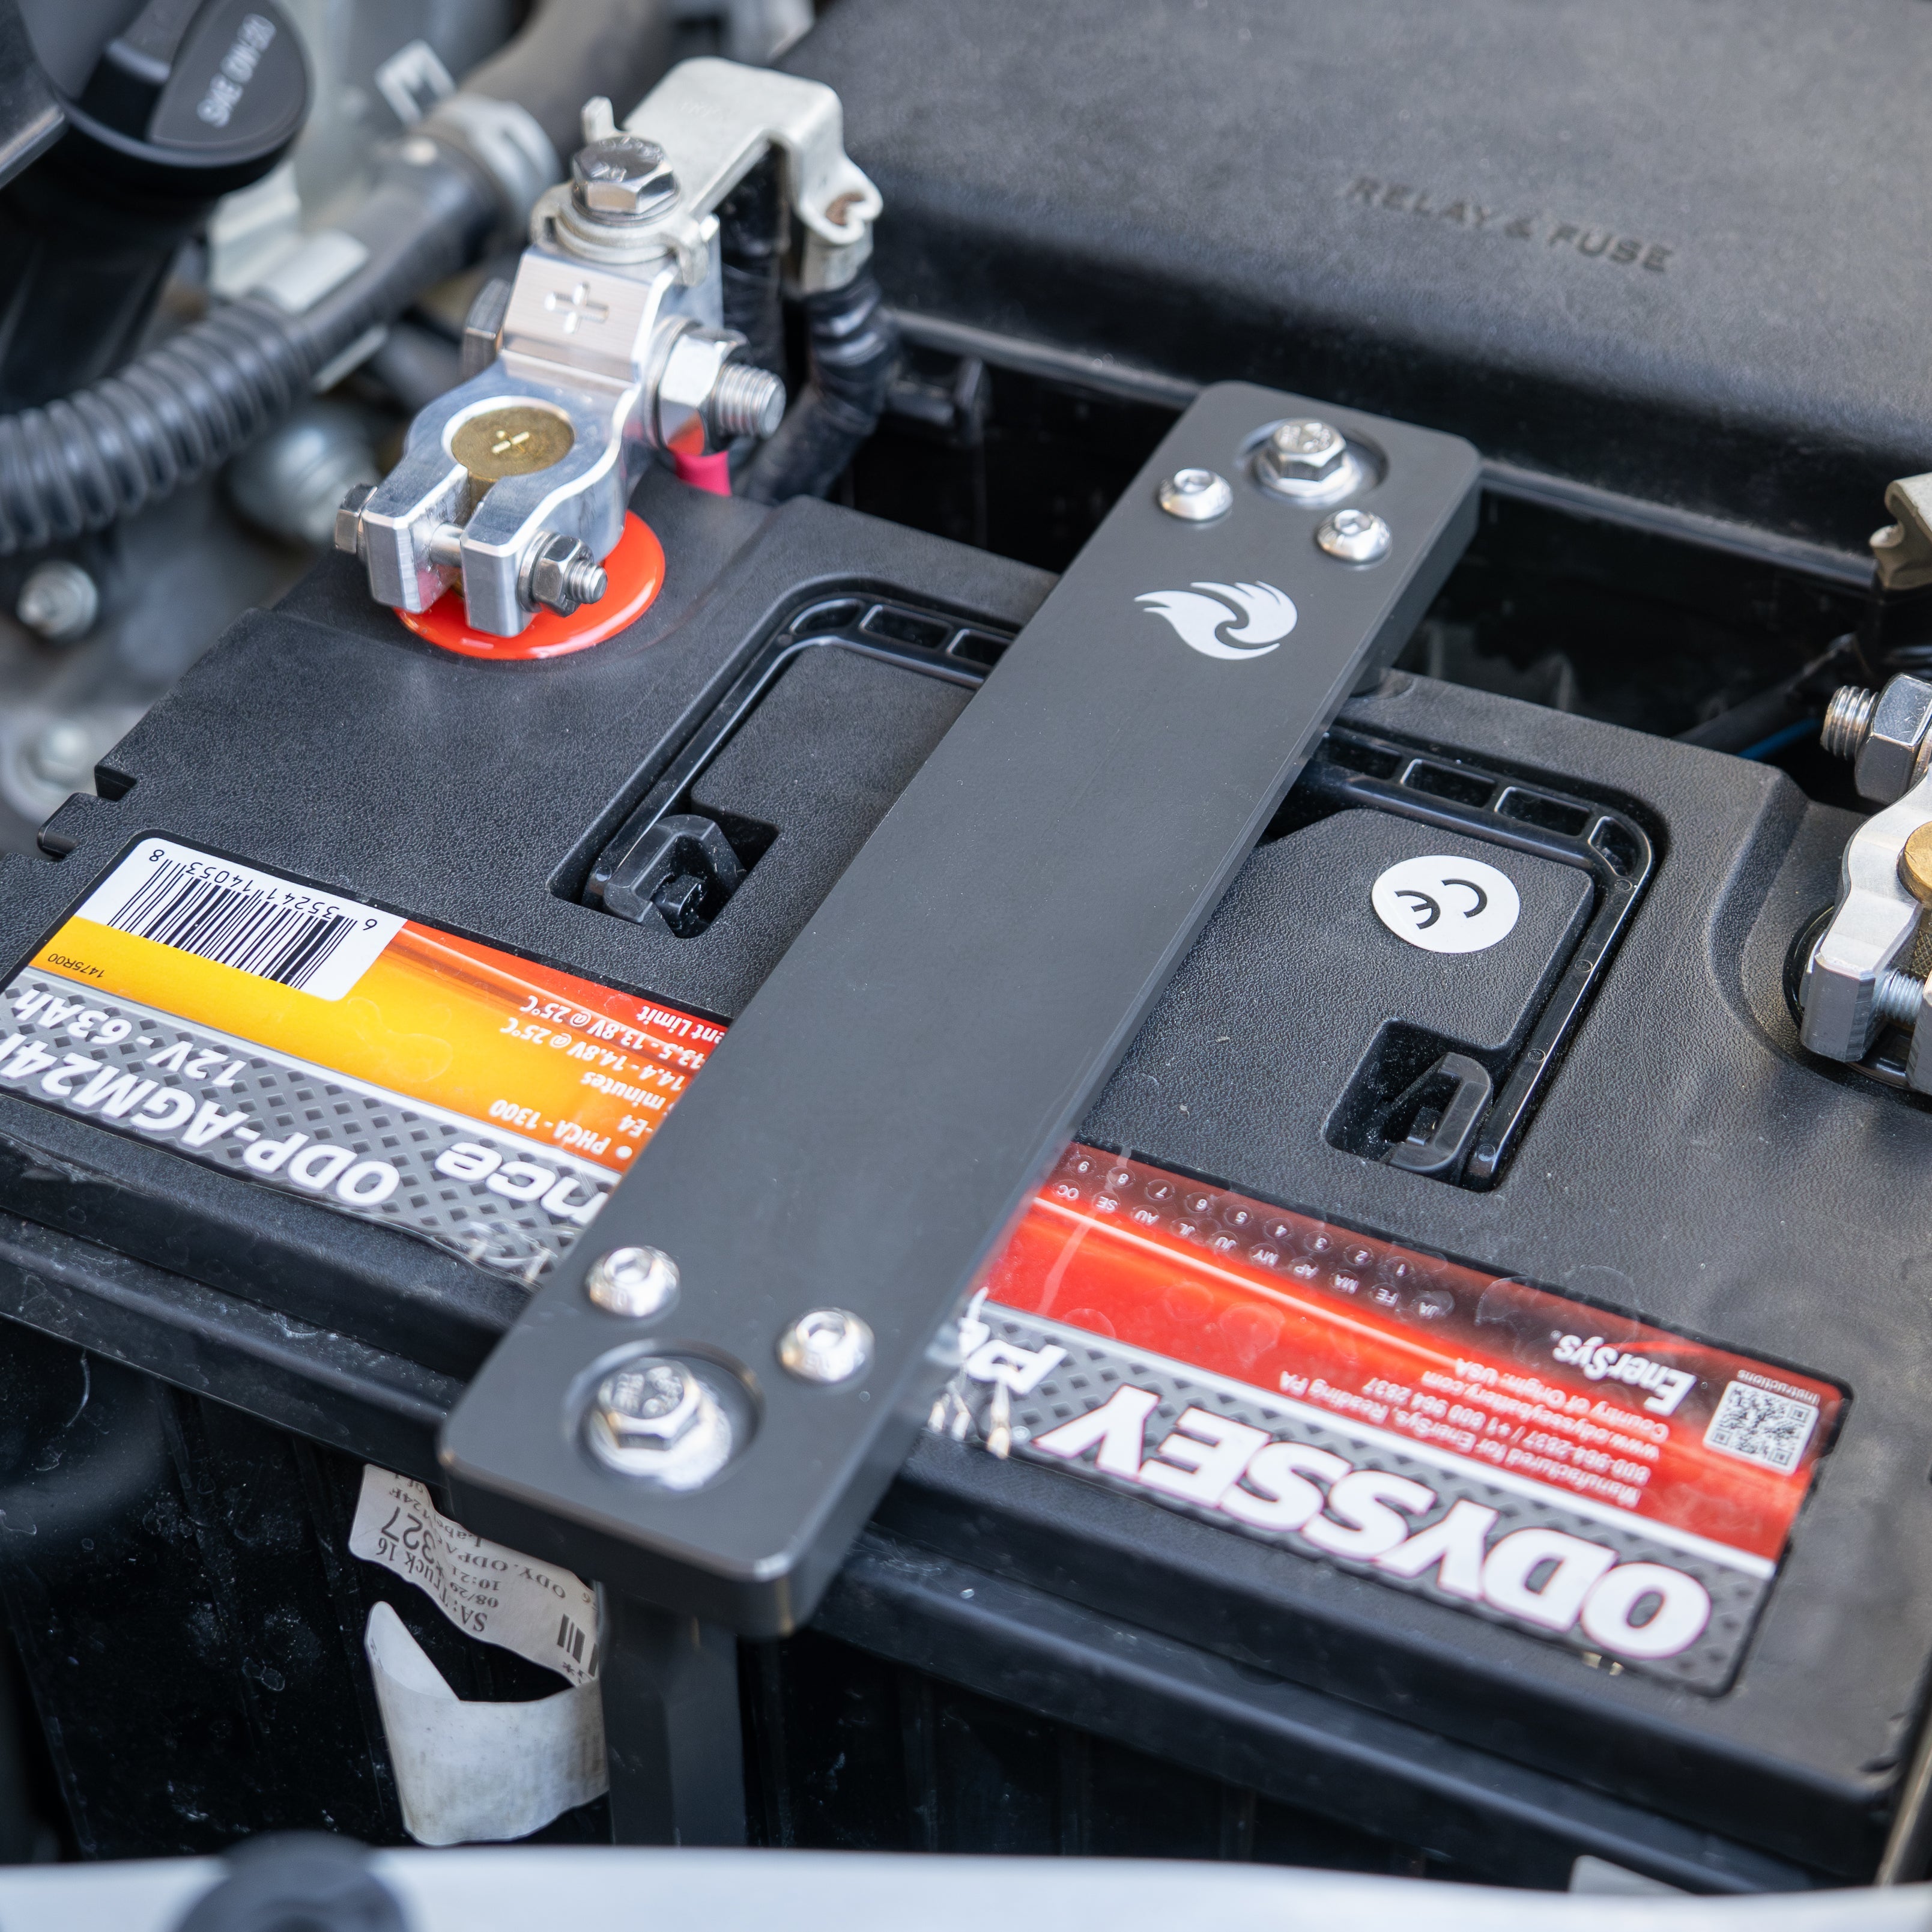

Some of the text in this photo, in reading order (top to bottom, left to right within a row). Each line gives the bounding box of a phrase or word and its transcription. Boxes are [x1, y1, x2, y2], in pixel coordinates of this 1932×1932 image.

[1346, 176, 1675, 274] RELAY & FUSE
[149, 849, 378, 931] 6 35241 14053 8
[1394, 878, 1488, 930] CE
[47, 952, 104, 978] 1475R00
[14, 989, 132, 1045] 63Ah
[569, 1011, 592, 1028] @
[637, 1005, 693, 1037] Limit
[549, 1033, 572, 1049] @
[587, 1020, 646, 1050] 13.8V
[146, 1040, 247, 1088] 12V
[566, 1041, 628, 1071] 14.8V
[658, 1043, 705, 1070] 13.5
[581, 1071, 666, 1110] minutes
[638, 1064, 685, 1091] 14.4
[489, 1100, 541, 1130] 1300
[618, 1114, 653, 1137] -E4
[553, 1119, 611, 1155] PHCA
[1056, 1184, 1079, 1201] OC
[1096, 1196, 1118, 1211] SE
[1078, 1161, 1405, 1278] 1 2 3 4 5 6 7 8 9
[1134, 1210, 1159, 1226] AU
[1179, 1223, 1196, 1237] JL
[1215, 1237, 1237, 1251] JU
[1252, 1249, 1279, 1267] MY
[1294, 1264, 1319, 1279] AP
[1334, 1274, 1359, 1294] MA
[1376, 1288, 1399, 1307] FE
[1280, 1370, 1309, 1396] PA
[1362, 1378, 1412, 1405] 2837
[1737, 1369, 1820, 1405] Instructions
[1308, 1378, 1388, 1424] Reading
[1411, 1392, 1449, 1418] 964
[1455, 1357, 1669, 1443] Country of Origin: USA
[1422, 1370, 1659, 1462] www.odysseybattery.com
[1447, 1404, 1486, 1431] 800
[1476, 1438, 1507, 1464] for
[1522, 1430, 1651, 1486] 800-964-2837
[1505, 1447, 1641, 1509] Manufactured
[1029, 1382, 1712, 1659] ODYSSEY
[376, 1537, 397, 1561] 16
[452, 1564, 501, 1591] 10:21
[450, 1582, 498, 1608] 08/29
